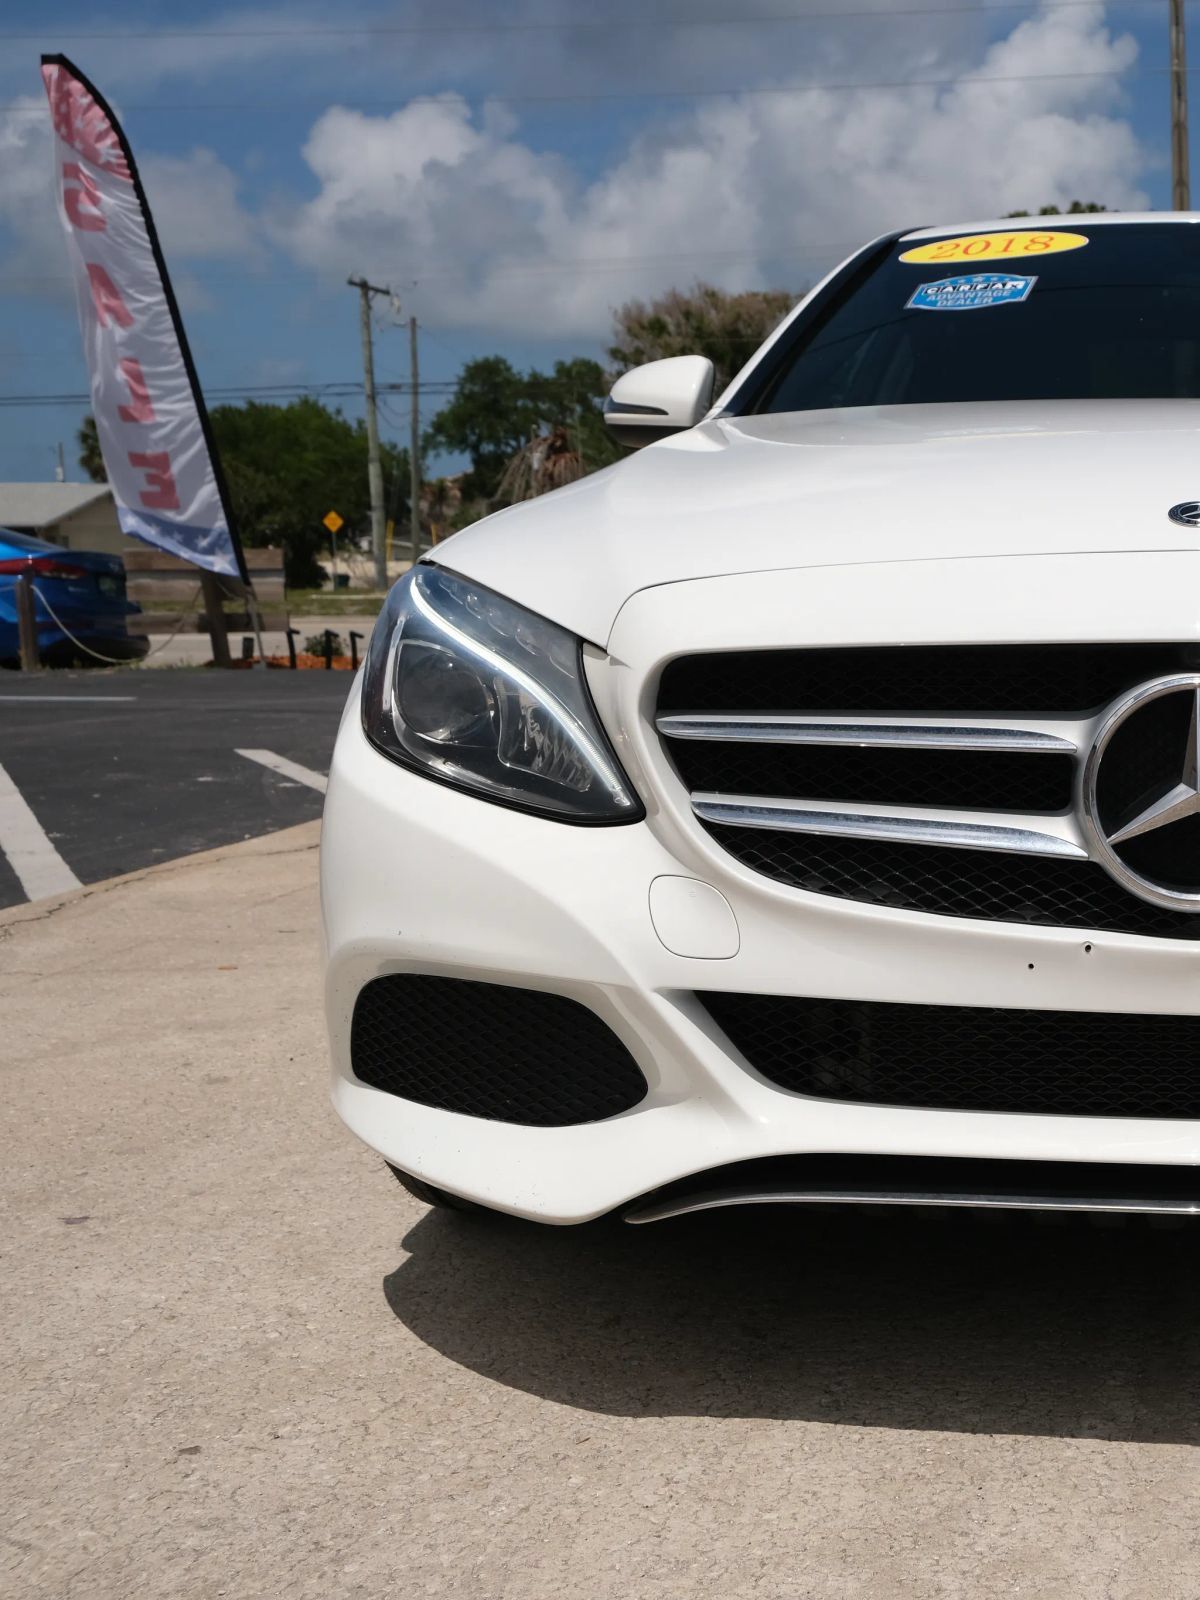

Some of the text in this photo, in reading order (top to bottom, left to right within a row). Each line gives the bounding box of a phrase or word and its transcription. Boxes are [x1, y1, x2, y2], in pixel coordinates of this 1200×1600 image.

[928, 235, 1056, 260] 2018
[922, 281, 1026, 295] CARFAX
[926, 289, 1012, 302] ADVANTAGE
[936, 297, 994, 307] DEALER
